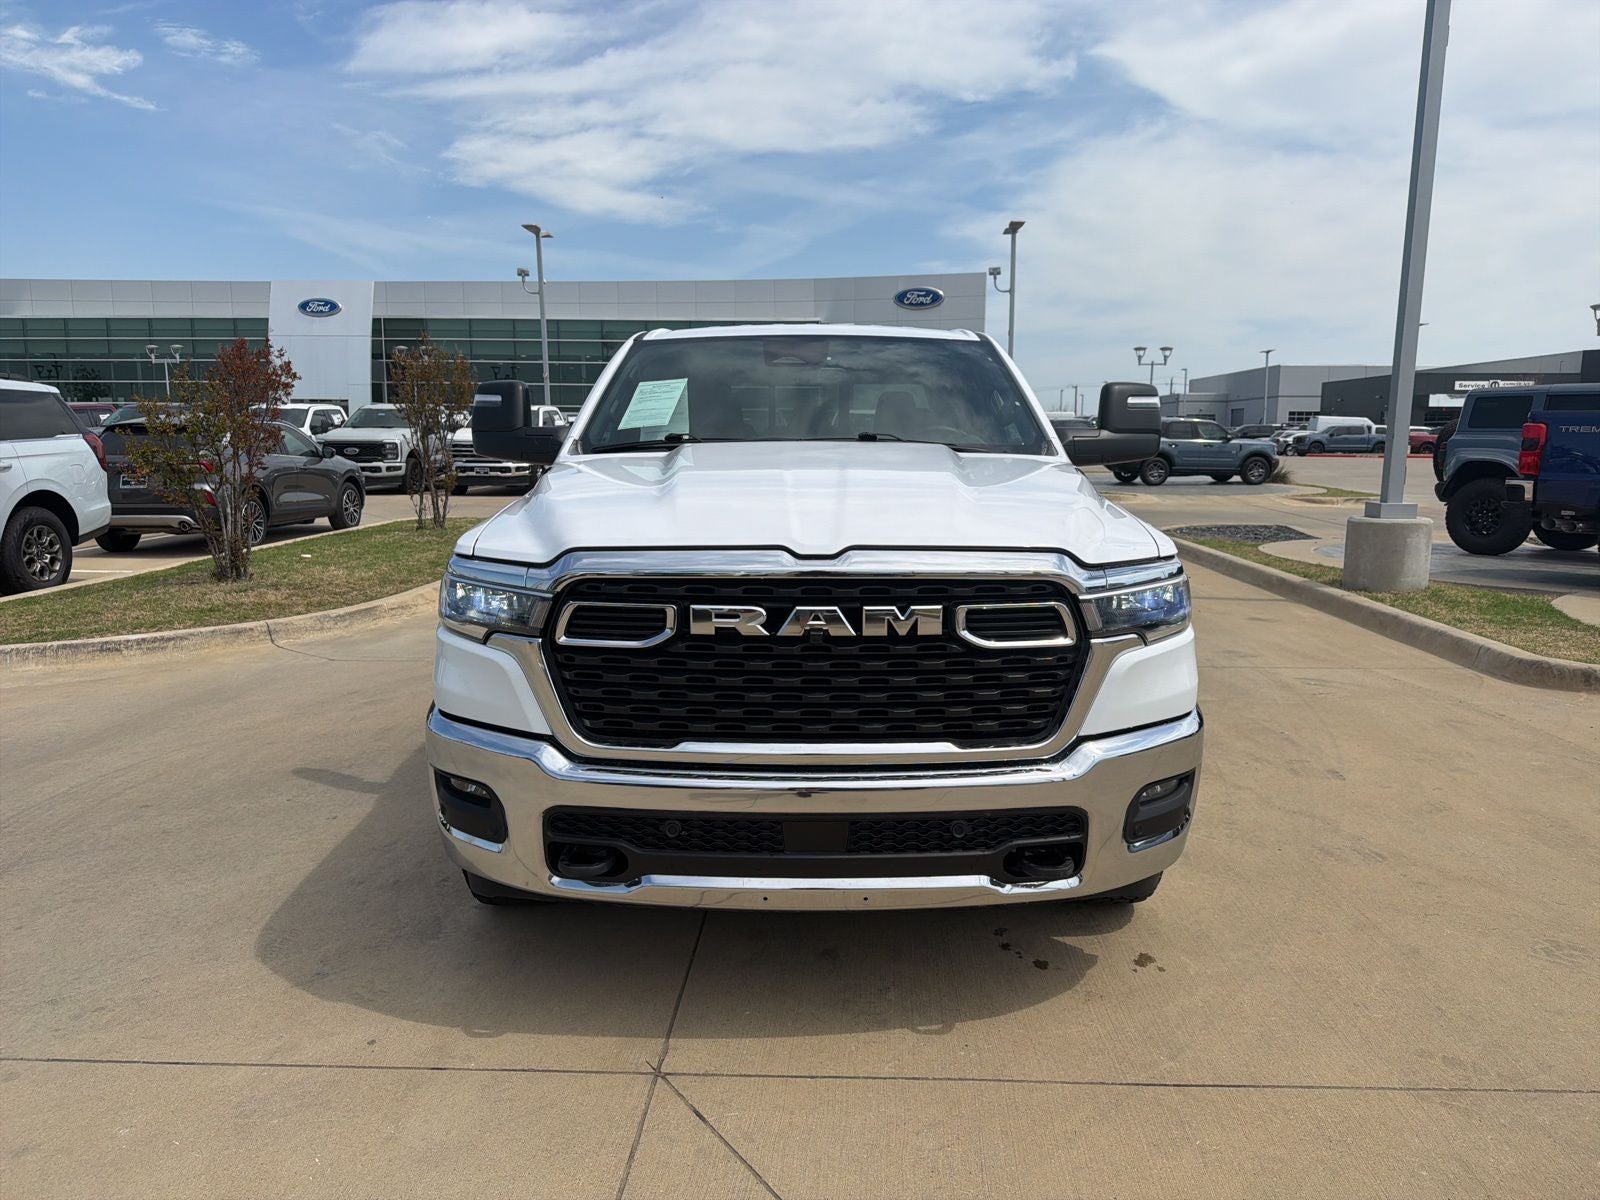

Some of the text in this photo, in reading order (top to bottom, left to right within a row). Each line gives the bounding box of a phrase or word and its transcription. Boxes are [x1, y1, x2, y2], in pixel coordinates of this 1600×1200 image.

[904, 291, 933, 304] Ford
[306, 301, 331, 312] Ford
[1458, 381, 1486, 389] Service
[690, 604, 943, 636] RAM
